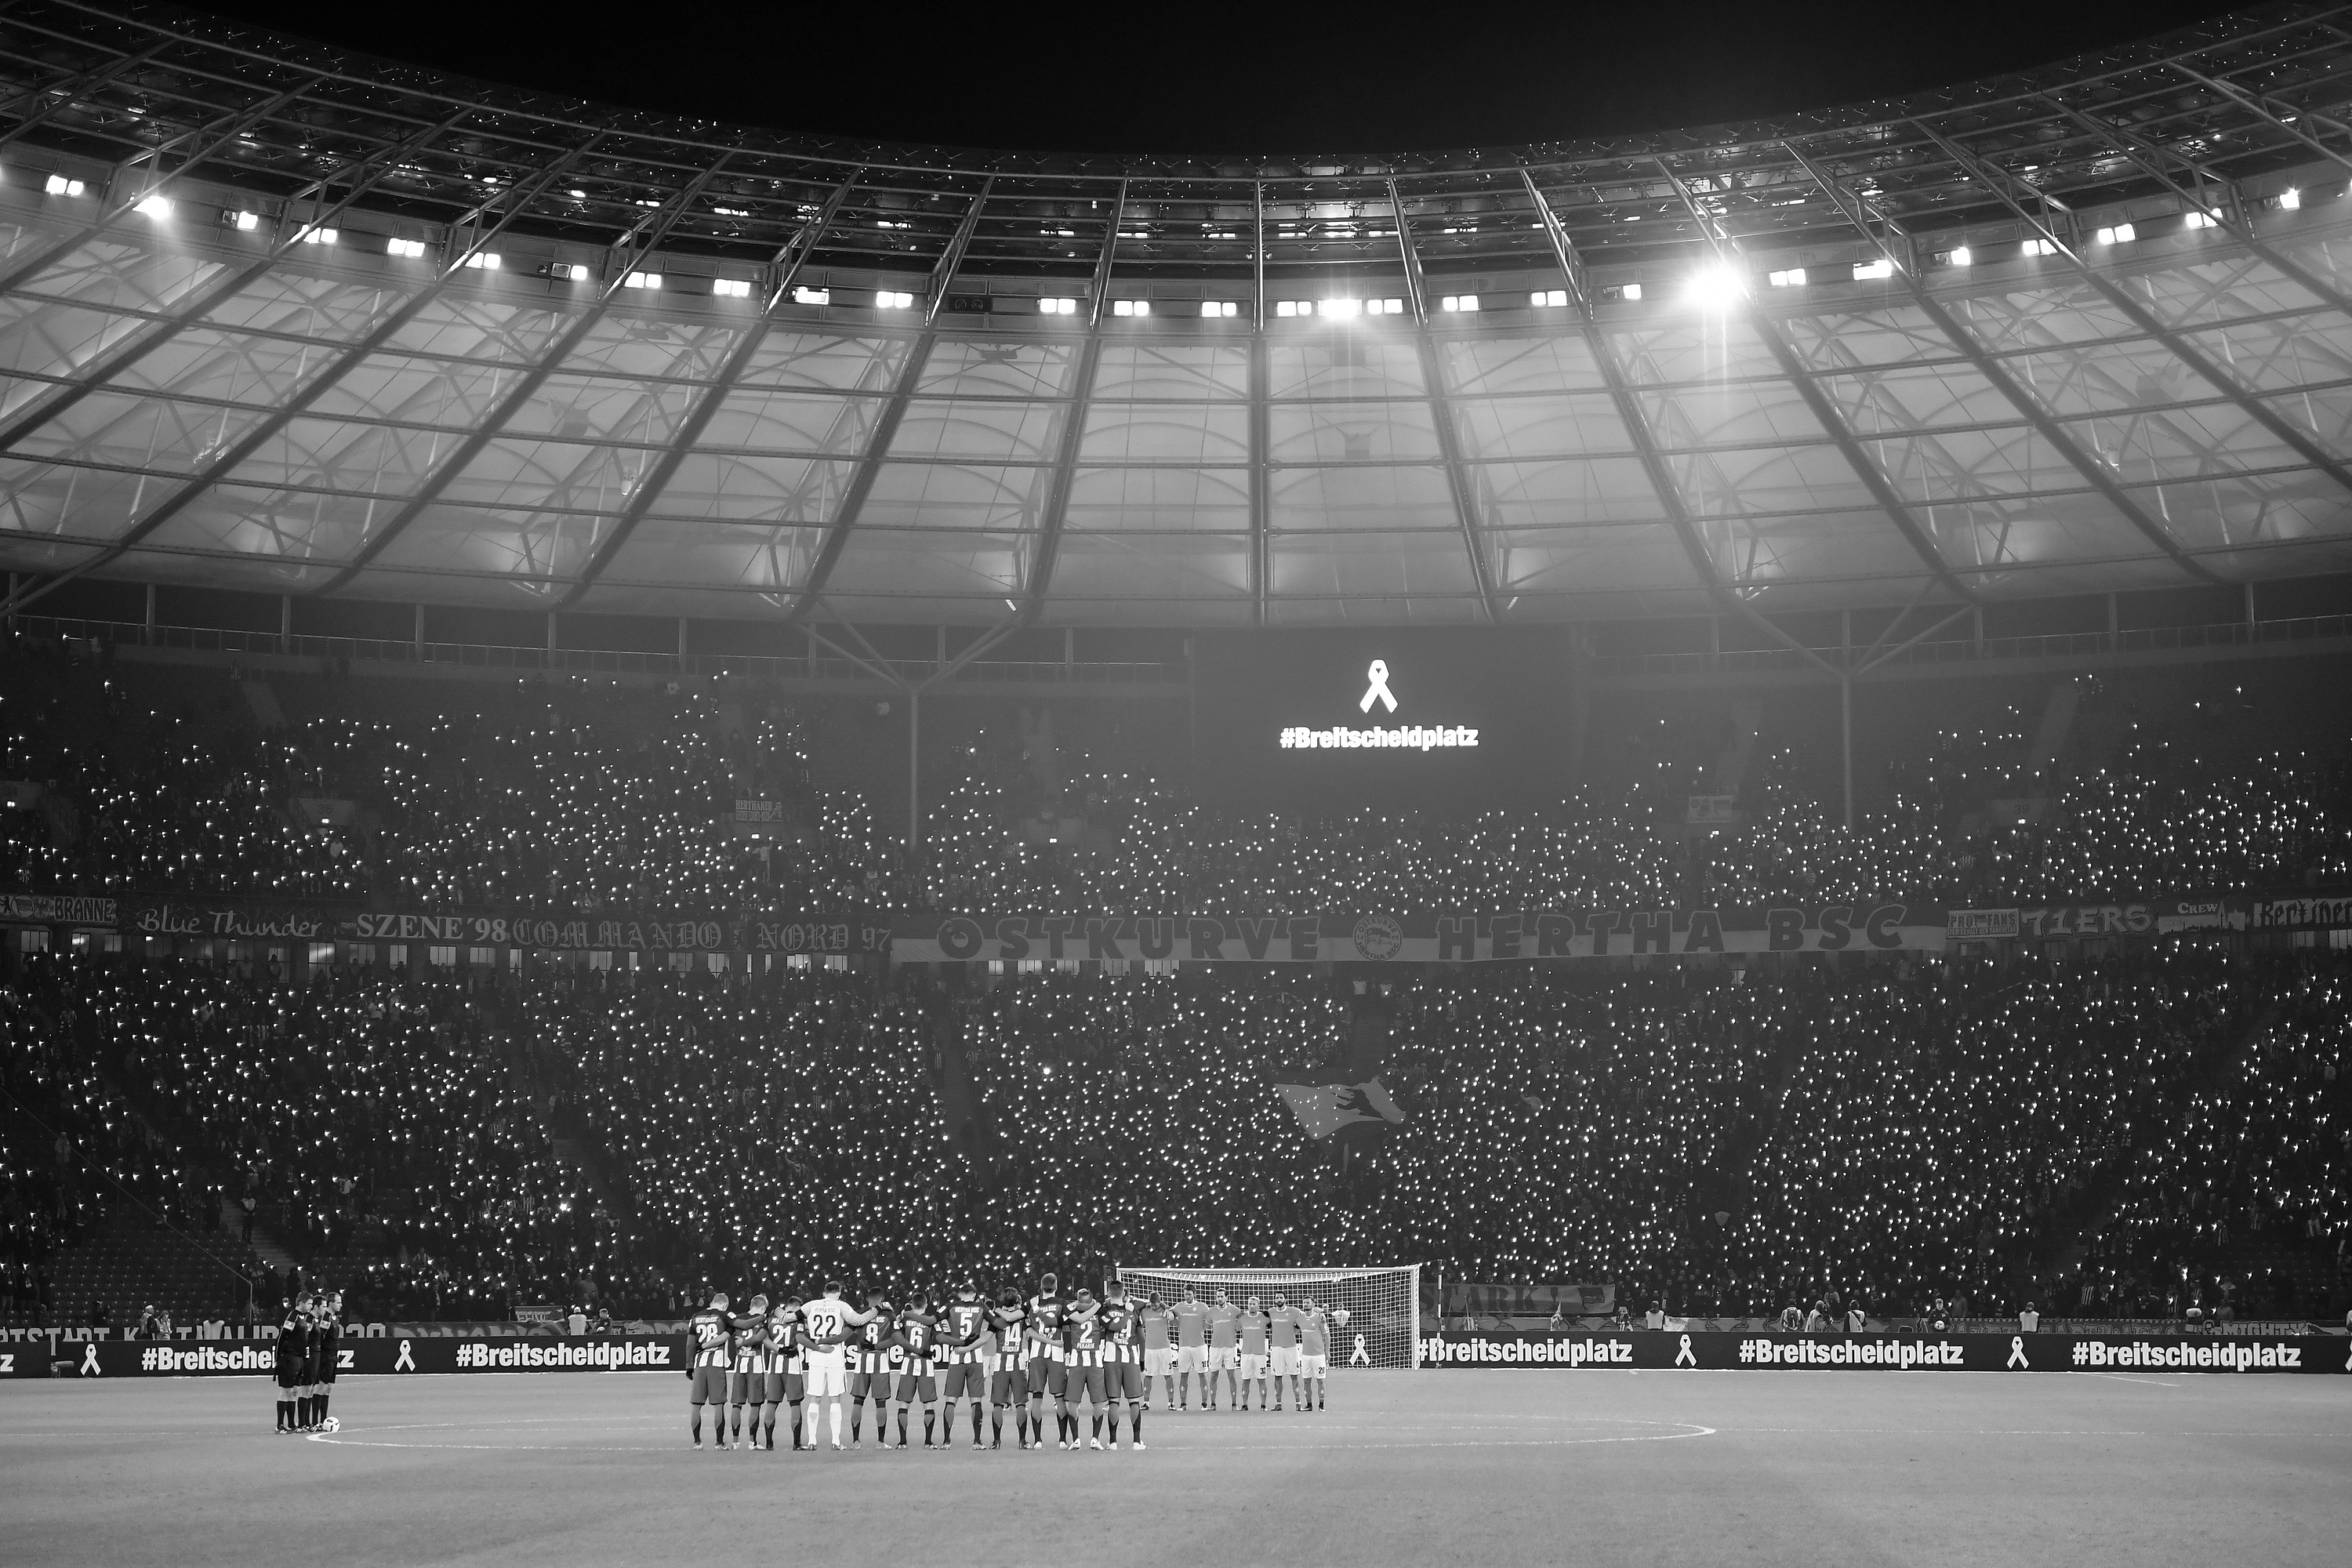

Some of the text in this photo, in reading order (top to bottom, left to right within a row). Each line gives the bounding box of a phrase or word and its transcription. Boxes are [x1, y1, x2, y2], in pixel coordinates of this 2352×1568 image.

[1280, 725, 1479, 751] #Breitscheidplatz
[136, 905, 323, 937] Blue Thunder
[357, 913, 463, 939] SZENE
[1438, 904, 1907, 960] HERTHA BSC
[1950, 913, 2016, 928] PRO FANS
[2020, 904, 2154, 937] 71ERS
[757, 920, 850, 952] NORD
[937, 916, 1321, 960] OSTKURVE
[772, 1324, 791, 1348] 21
[813, 1315, 836, 1338] 22
[909, 1327, 924, 1348] 6
[960, 1313, 973, 1336] 5
[1004, 1323, 1022, 1345] 14
[1080, 1321, 1092, 1343] 2
[456, 1341, 670, 1370] #Breitscheidplatz
[1739, 1339, 1964, 1369] #Breitscheidplatz
[2072, 1341, 2302, 1371] #Breitscheidplatz
